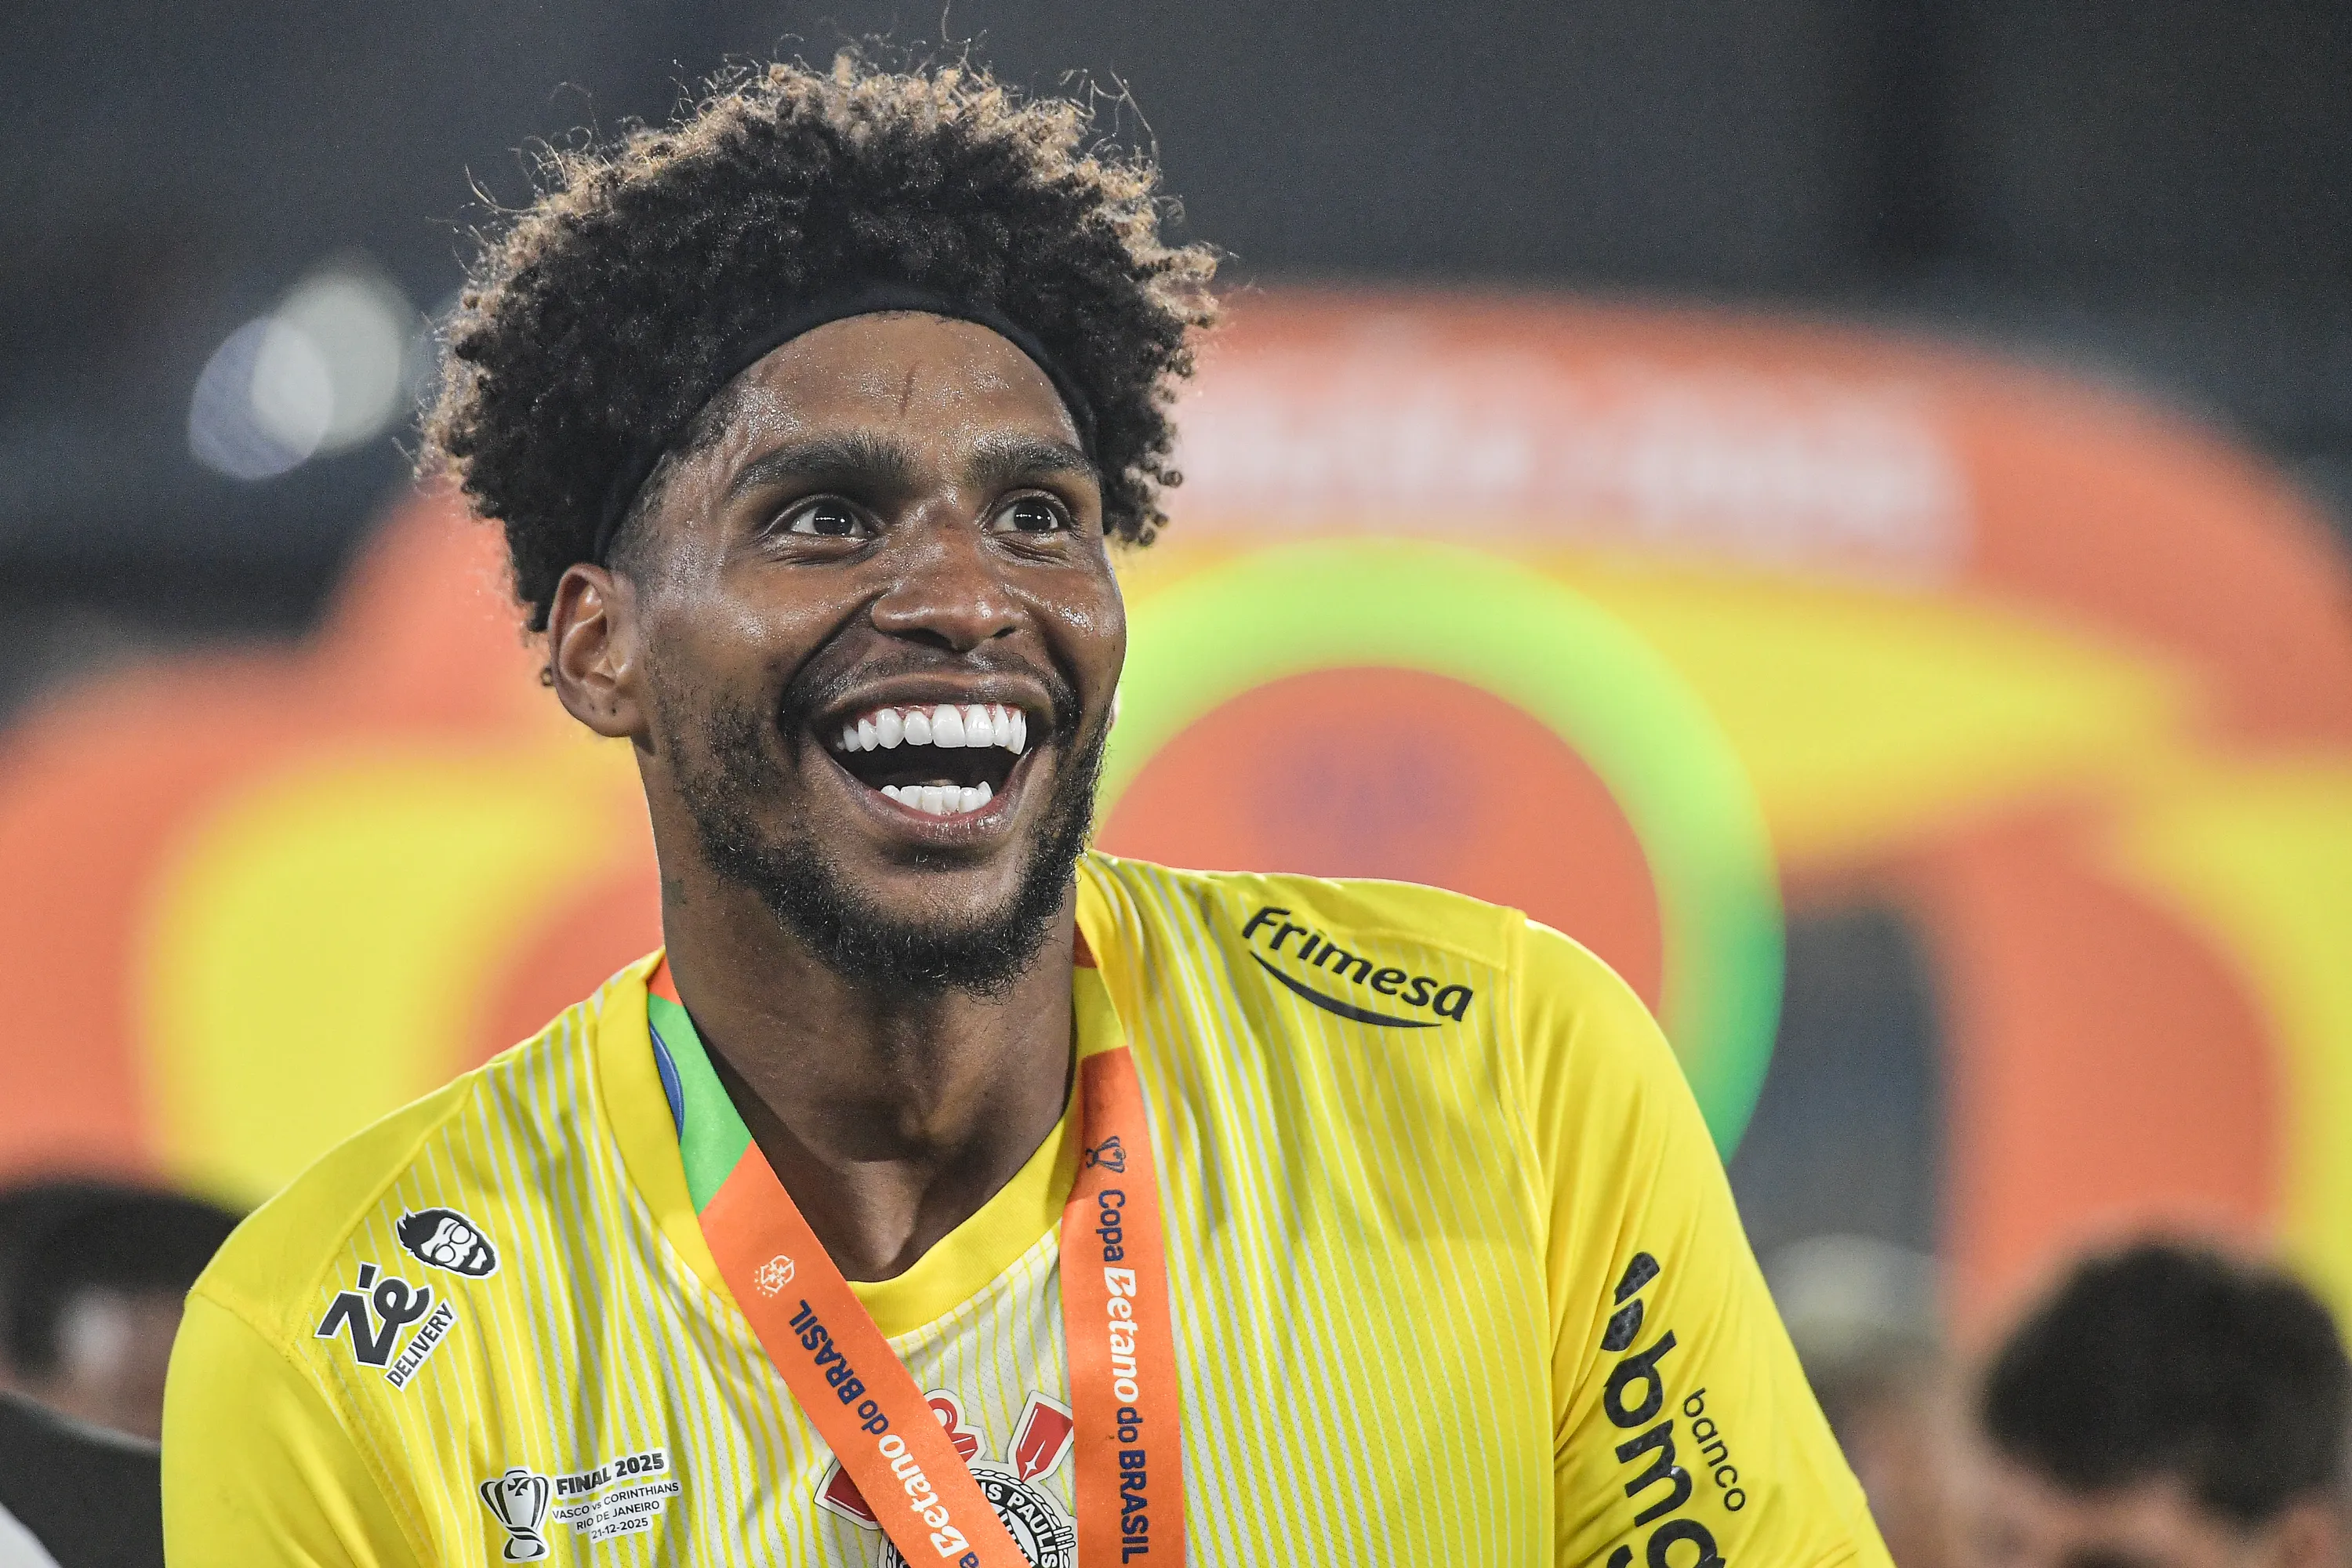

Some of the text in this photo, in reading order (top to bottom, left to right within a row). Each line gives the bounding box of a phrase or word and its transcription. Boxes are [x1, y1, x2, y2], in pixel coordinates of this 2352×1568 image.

[1242, 906, 1474, 1022] Frimesa
[317, 1263, 430, 1366] Zé
[387, 1302, 455, 1388] DELIVERY
[1096, 1189, 1149, 1564] Copa Betano do BRASIL
[556, 1453, 665, 1495] FINAL 2025
[789, 1299, 970, 1558] Betano do BRASIL
[1683, 1387, 1746, 1512] banco
[552, 1483, 679, 1519] VASCO vs CORINTHIANS
[577, 1501, 660, 1530] RIO DE JANEIRO
[591, 1518, 648, 1539] 21-12-2025
